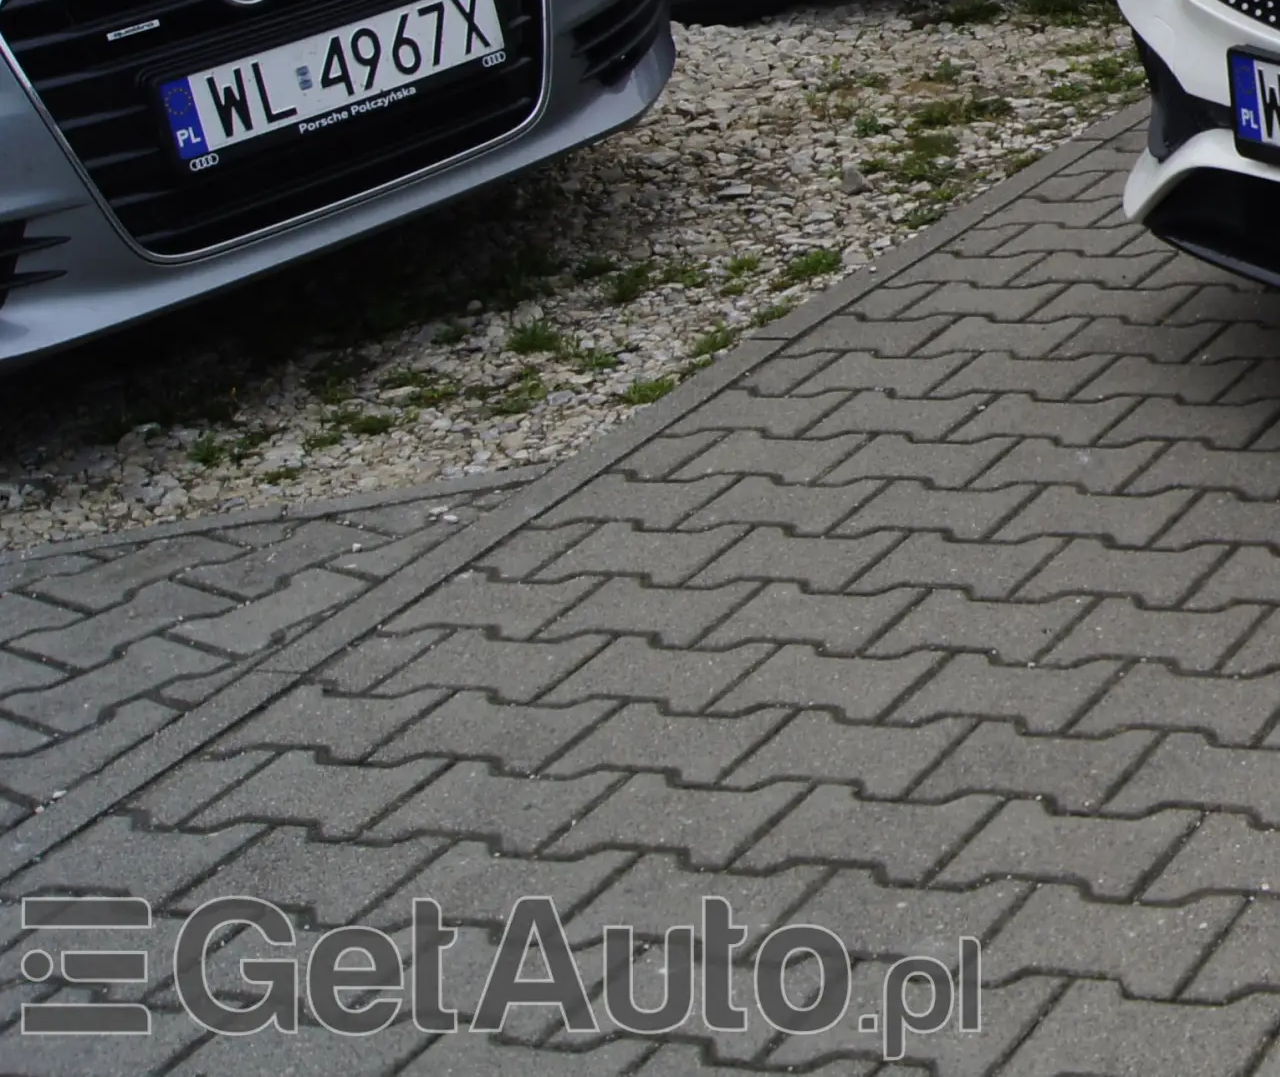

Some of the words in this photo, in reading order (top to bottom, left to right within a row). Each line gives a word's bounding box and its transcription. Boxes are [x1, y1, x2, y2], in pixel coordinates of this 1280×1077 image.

[205, 62, 298, 138] WL
[298, 110, 349, 134] Porsche
[1241, 108, 1259, 129] PL
[176, 126, 202, 148] PL
